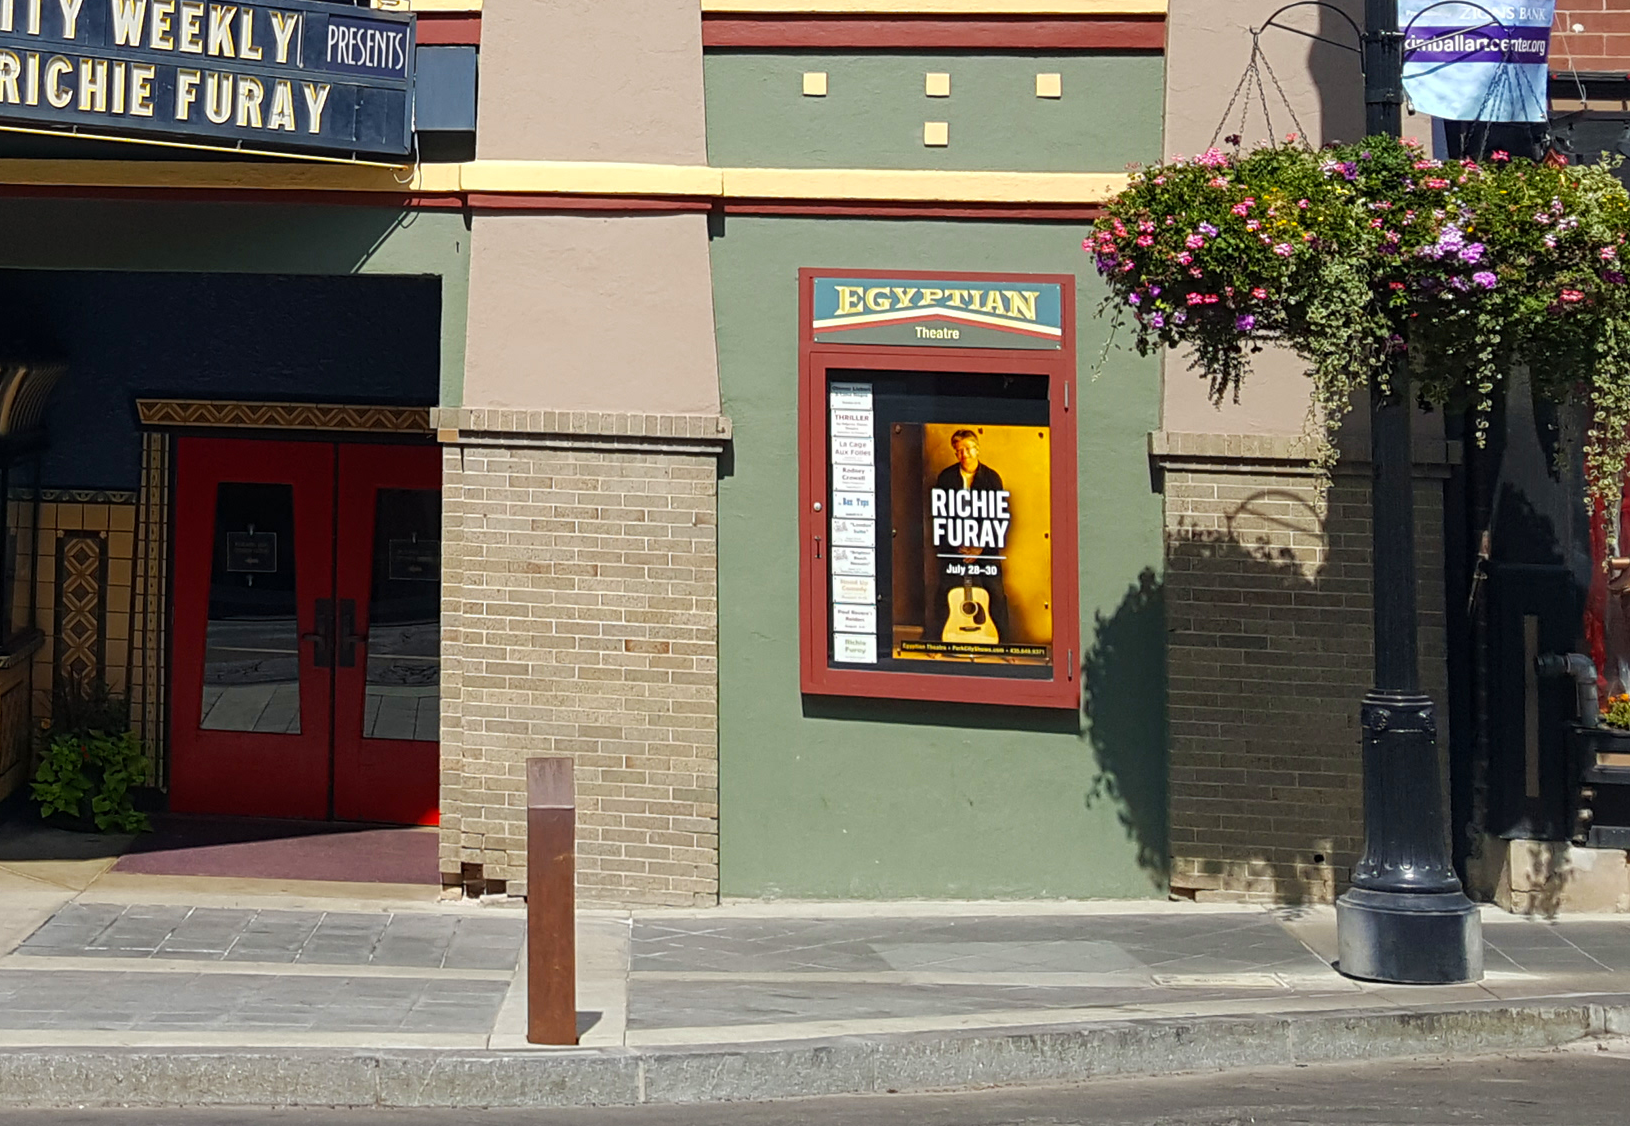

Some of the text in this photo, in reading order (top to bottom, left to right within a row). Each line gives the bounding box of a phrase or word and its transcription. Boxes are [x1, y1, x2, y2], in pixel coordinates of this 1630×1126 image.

[1519, 7, 1546, 21] BANK
[327, 23, 405, 70] PRESENTS
[174, 68, 331, 134] FURAY
[834, 285, 1040, 321] EGYPTIAN
[915, 326, 960, 340] Theatre
[931, 488, 1010, 519] RICHIE
[933, 518, 1009, 548] FURAY
[946, 563, 966, 576] July
[902, 642, 926, 650] Egyptian
